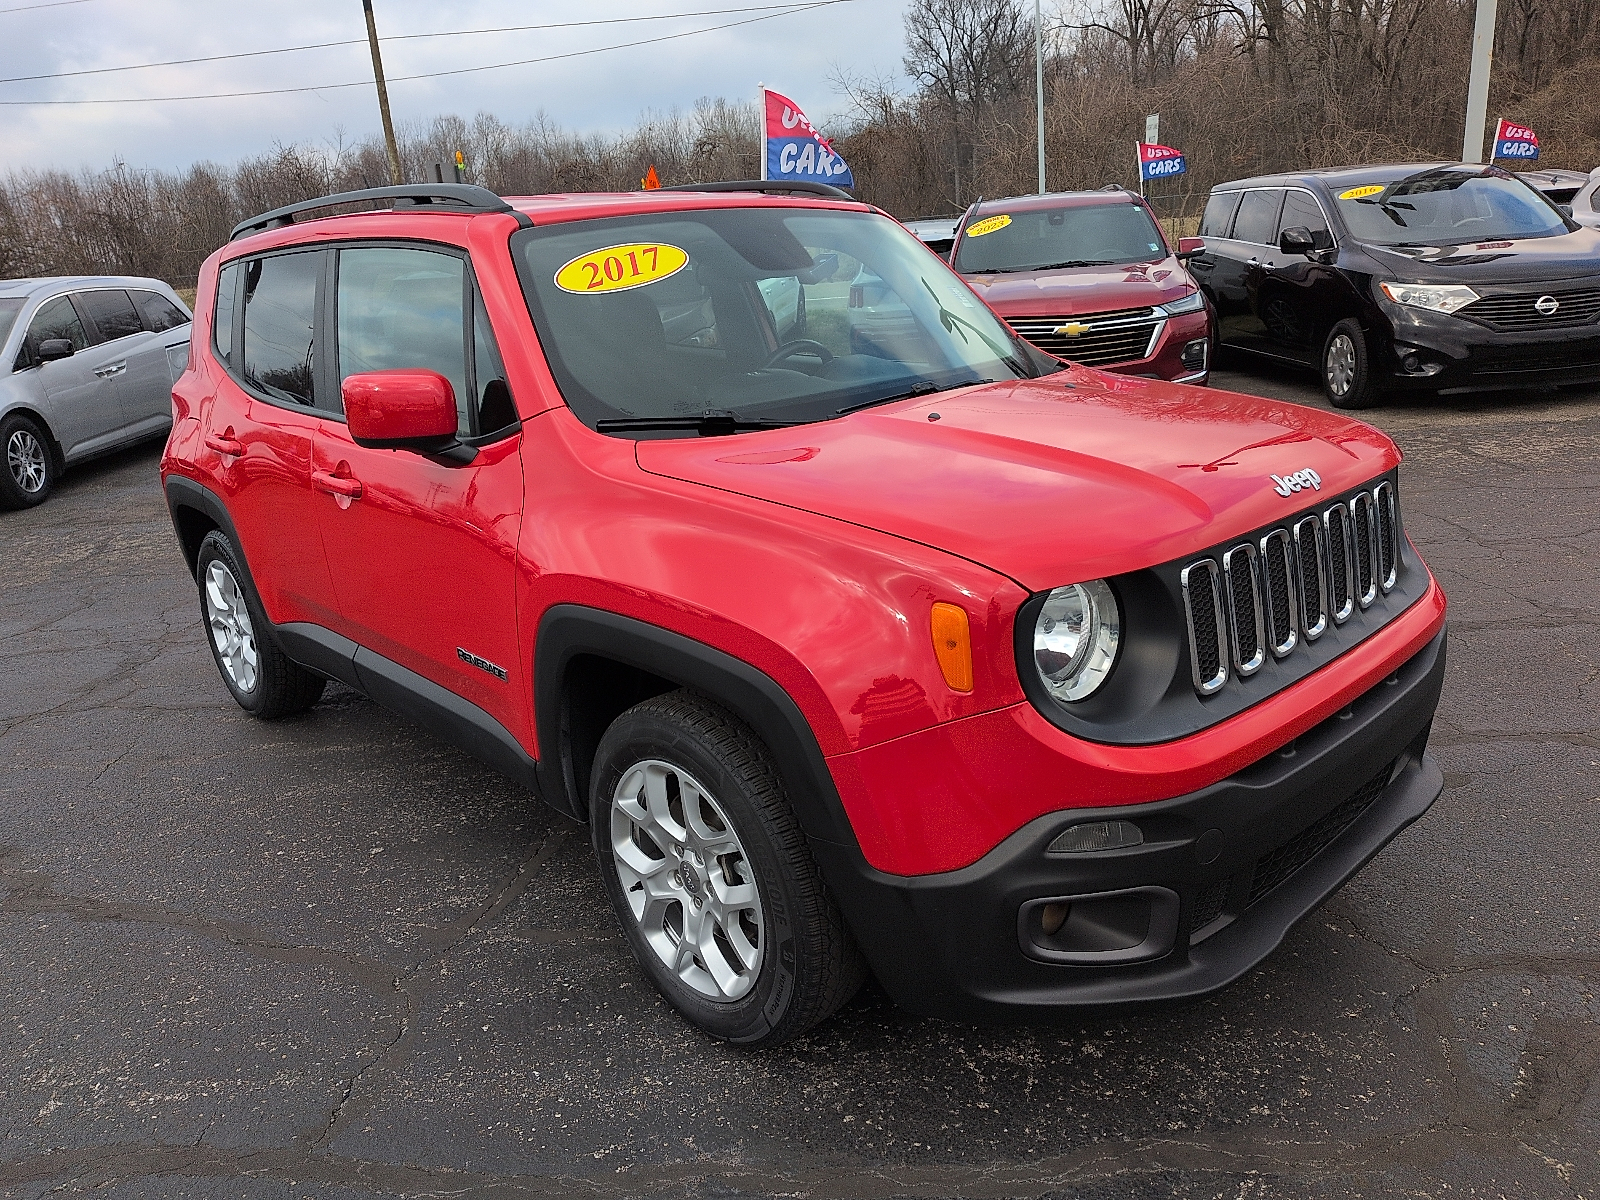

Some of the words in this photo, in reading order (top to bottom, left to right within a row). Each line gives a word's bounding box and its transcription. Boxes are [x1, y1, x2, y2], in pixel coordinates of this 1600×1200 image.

[1147, 147, 1174, 158] USE
[1502, 142, 1537, 156] CARS
[1148, 158, 1180, 175] CARS
[1349, 187, 1376, 198] 2016
[976, 220, 1005, 235] 2023
[581, 246, 658, 290] 2017
[1269, 467, 1321, 498] Jeep
[456, 646, 509, 683] RENEGADE
